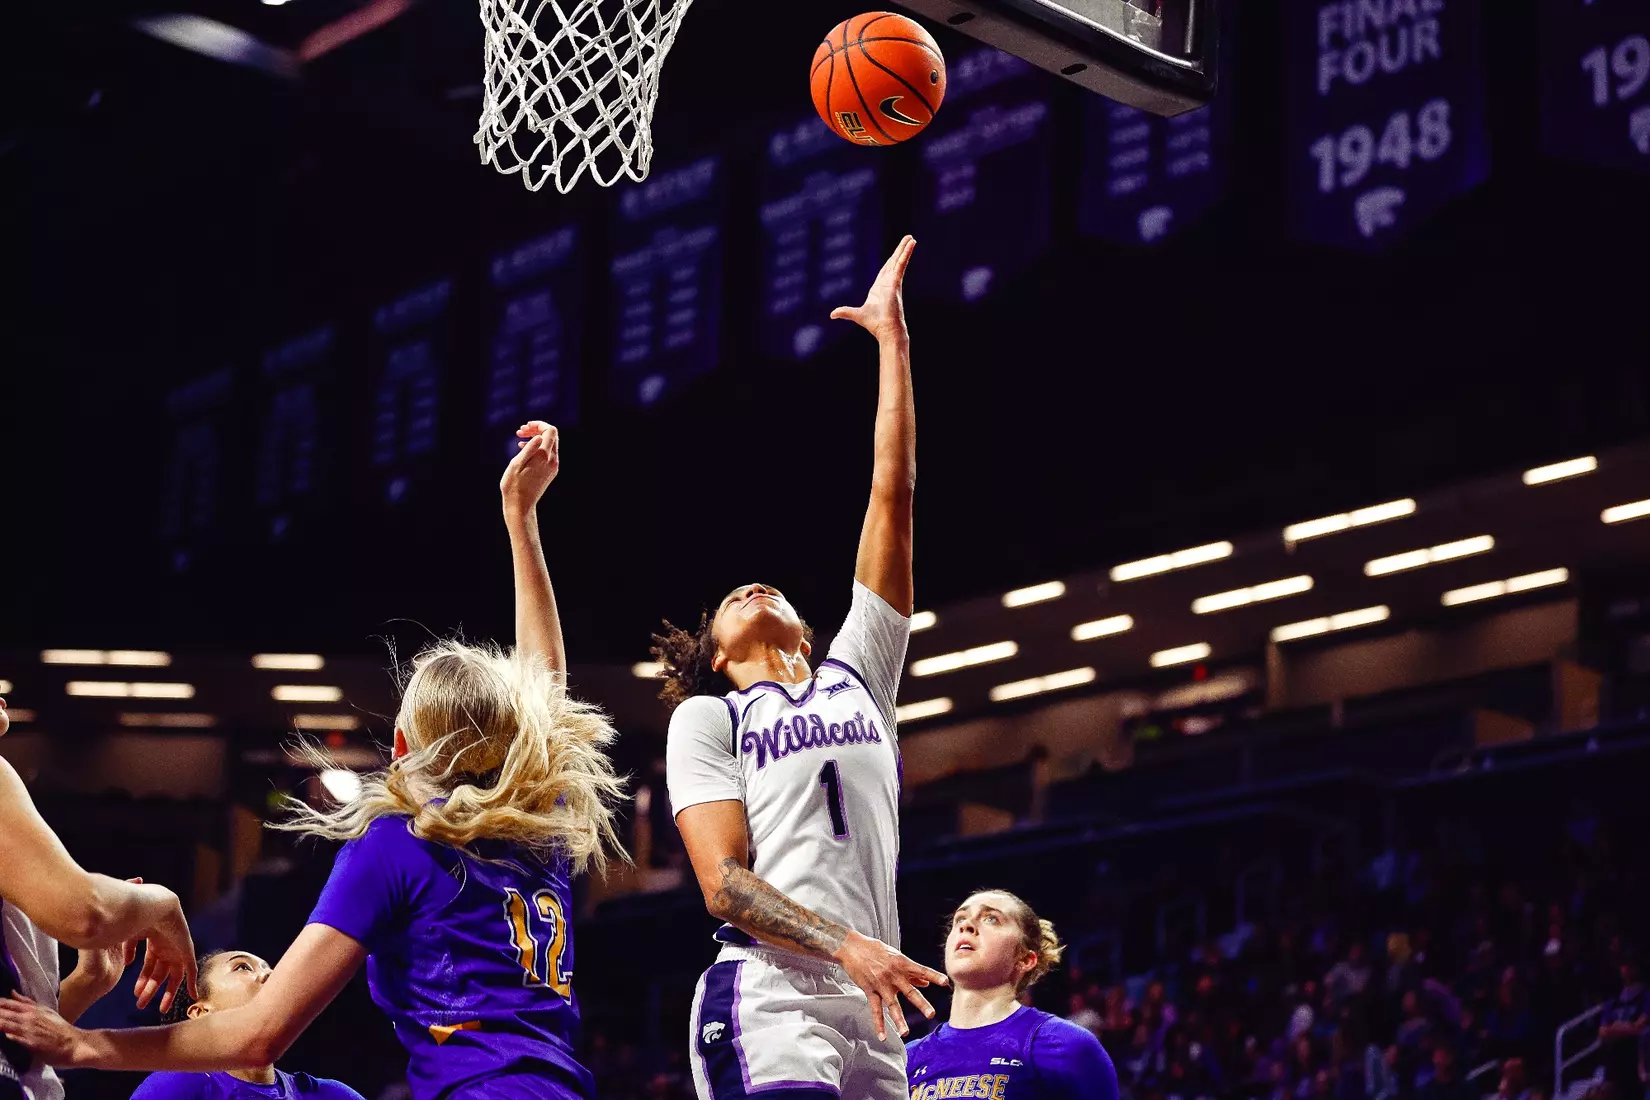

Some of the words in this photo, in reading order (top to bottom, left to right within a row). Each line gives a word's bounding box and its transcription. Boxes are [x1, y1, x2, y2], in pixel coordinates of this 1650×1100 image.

[1318, 0, 1446, 50] FIN
[1318, 18, 1442, 96] FOUR
[1310, 99, 1452, 192] 1948
[741, 711, 882, 771] Wildcats
[819, 759, 851, 841] 1
[503, 887, 573, 1006] 12
